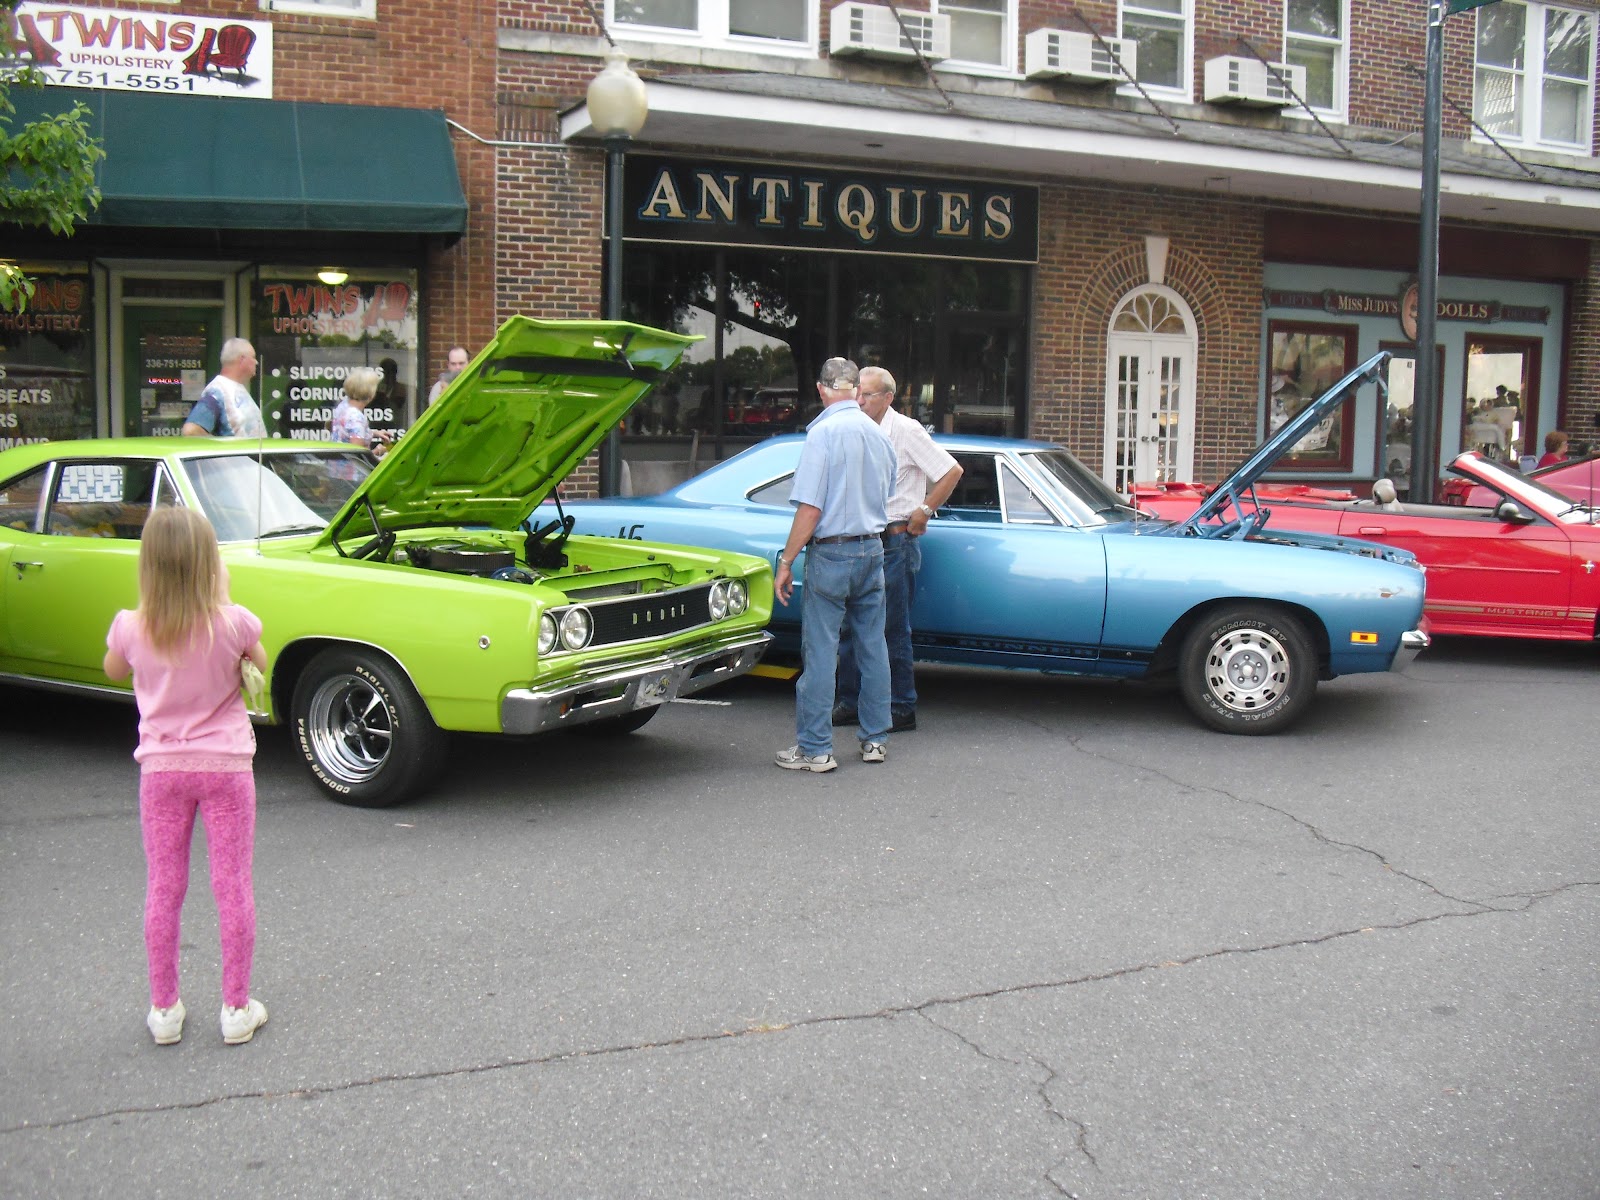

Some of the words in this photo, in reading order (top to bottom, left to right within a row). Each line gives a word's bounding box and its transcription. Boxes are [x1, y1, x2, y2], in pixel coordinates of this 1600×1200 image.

[37, 11, 196, 52] TWINS
[70, 53, 174, 70] UPHOLSTERY
[640, 169, 1013, 241] ANTIQUES
[264, 284, 361, 315] TWINS
[1338, 295, 1363, 311] MISS
[1364, 297, 1399, 314] JUDY'S
[1436, 302, 1488, 318] DOLLS
[273, 317, 357, 335] UPHOLSTERY
[632, 604, 685, 625] DODGE
[1487, 607, 1554, 618] MUSTANG
[355, 666, 389, 702] RADIAL
[1242, 695, 1290, 720] RADIAL
[298, 718, 313, 761] COBRA
[311, 764, 350, 794] COOPER
